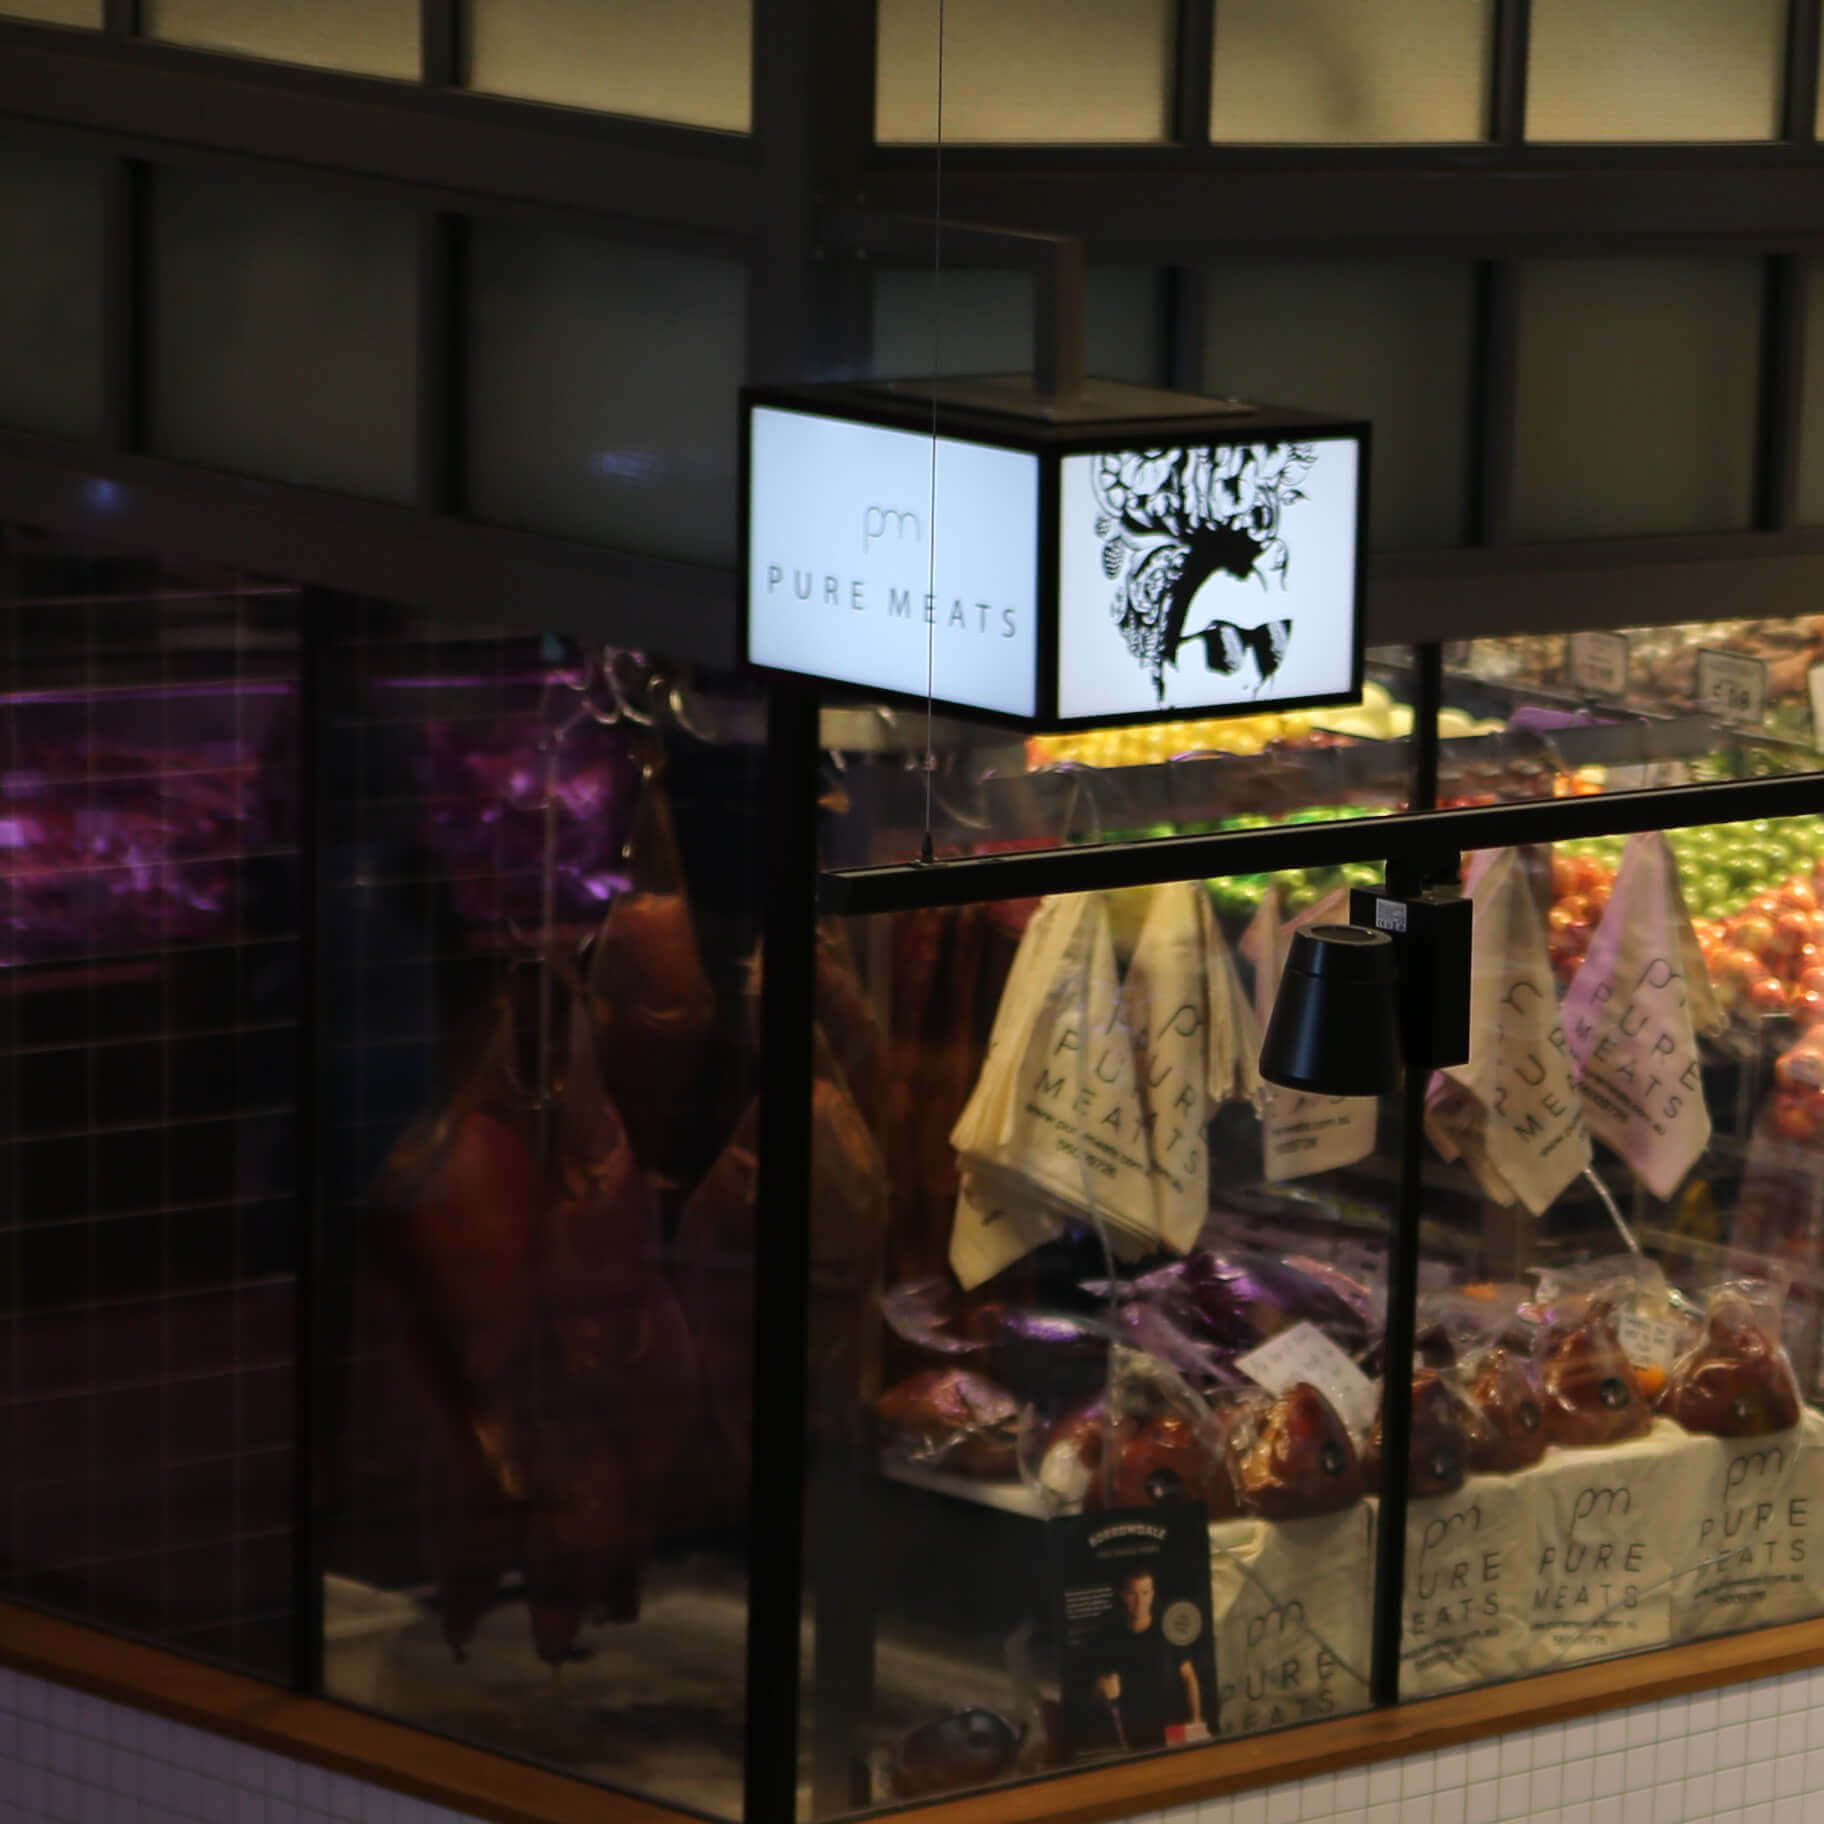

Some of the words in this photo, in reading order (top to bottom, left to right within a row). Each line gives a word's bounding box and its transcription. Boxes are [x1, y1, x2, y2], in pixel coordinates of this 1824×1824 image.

[767, 564, 864, 611] PURE
[888, 593, 1018, 639] MEATS
[1538, 1541, 1648, 1577] PURE
